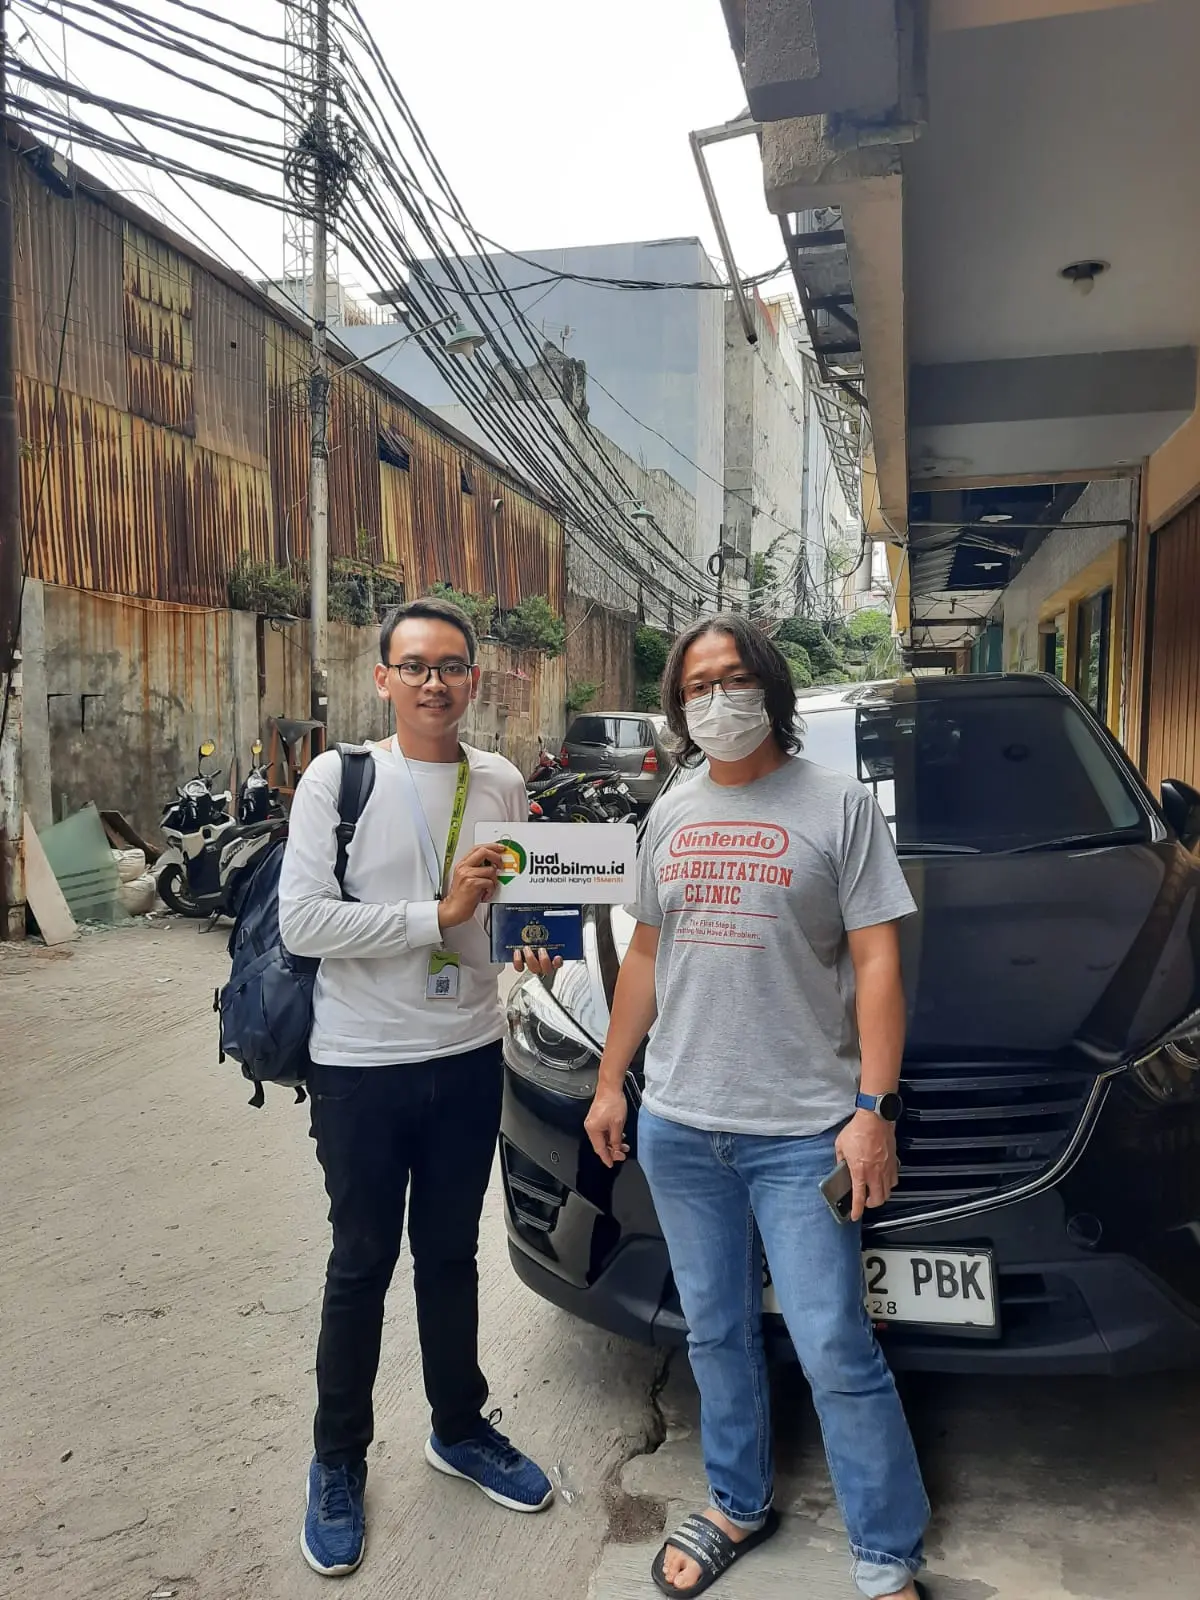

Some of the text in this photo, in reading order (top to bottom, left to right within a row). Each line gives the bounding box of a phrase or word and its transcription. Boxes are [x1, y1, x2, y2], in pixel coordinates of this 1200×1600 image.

[676, 831, 776, 850] Nintendo
[528, 851, 559, 874] jual
[535, 861, 625, 875] mobilmu.id
[529, 876, 546, 884] Jual
[547, 876, 567, 884] Mobil
[568, 876, 592, 885] Hanya
[659, 860, 794, 888] REHABILITATION
[684, 883, 742, 905] CLINIC
[700, 919, 714, 928] First
[715, 920, 730, 929] Step
[706, 929, 723, 937] Have
[909, 1257, 986, 1300] PBK
